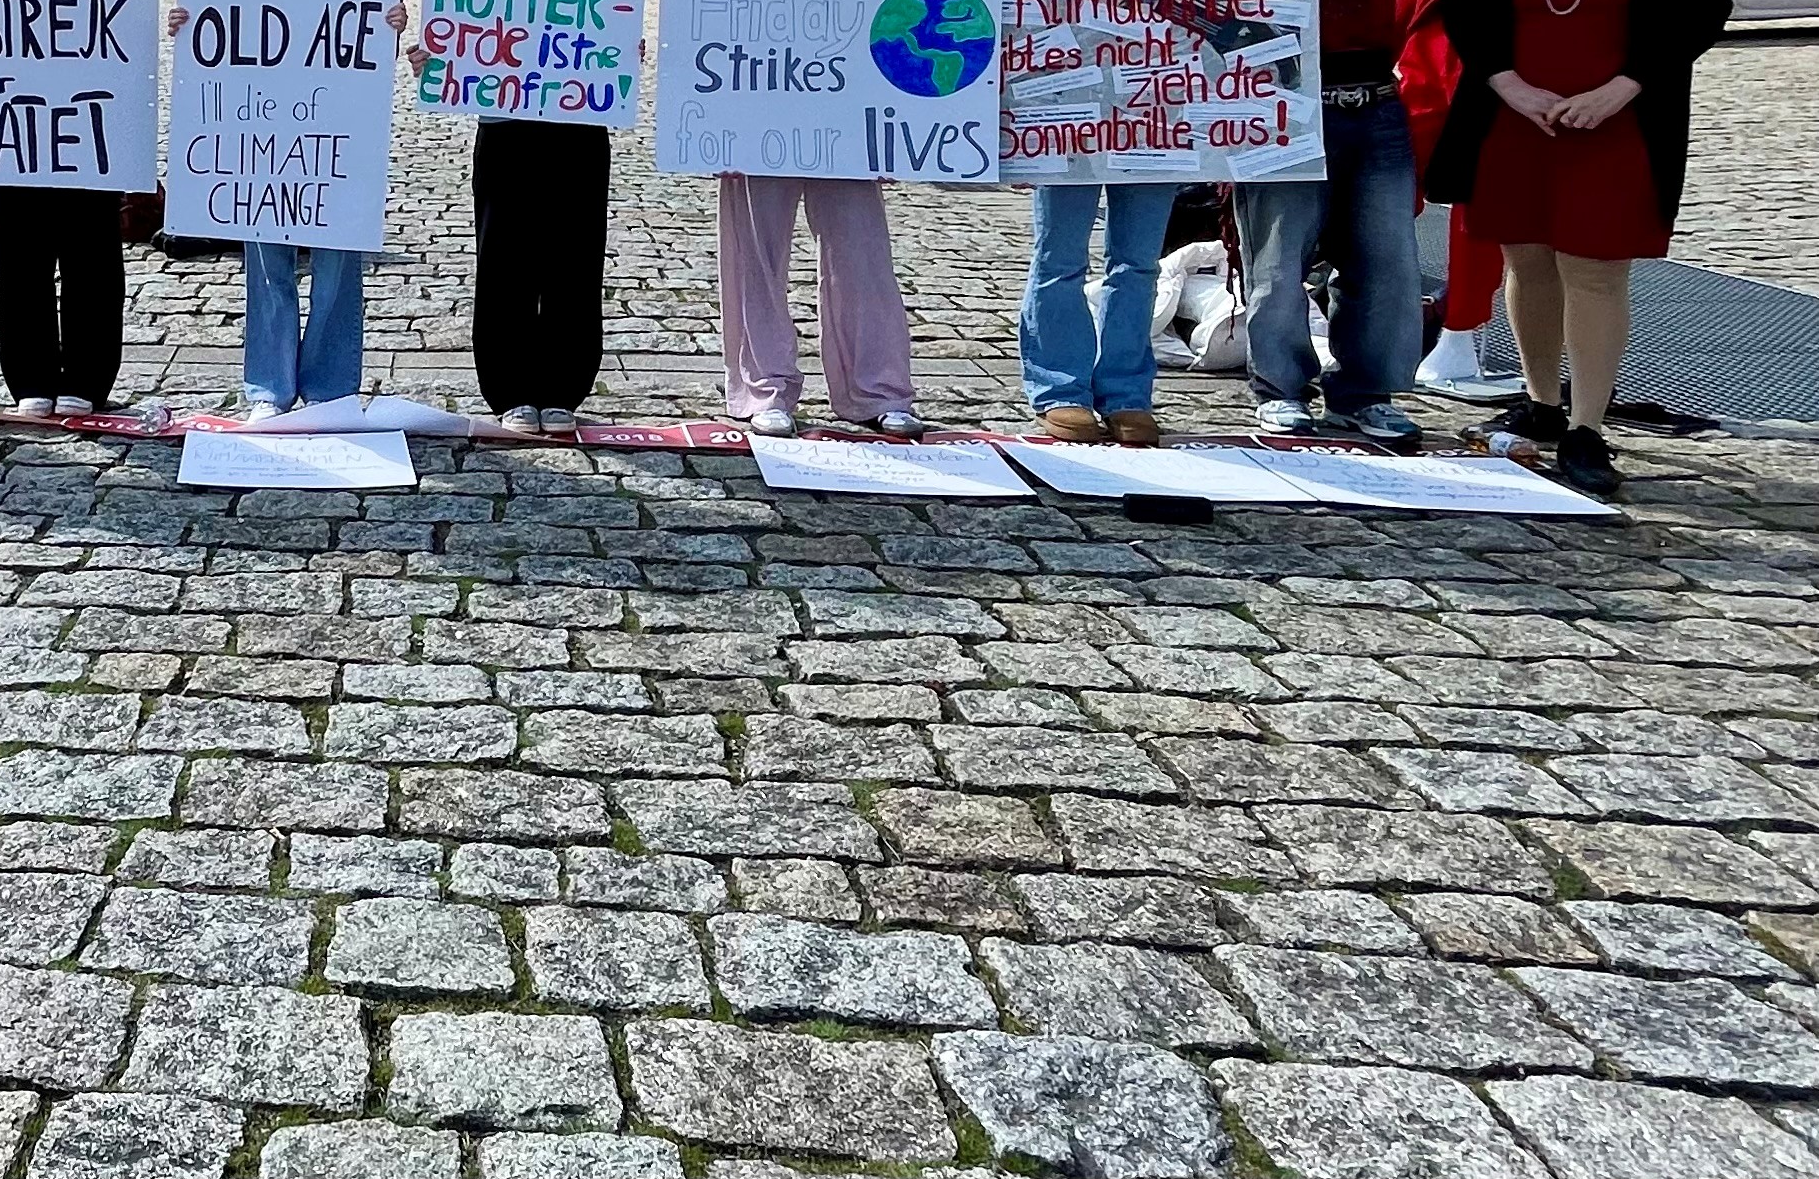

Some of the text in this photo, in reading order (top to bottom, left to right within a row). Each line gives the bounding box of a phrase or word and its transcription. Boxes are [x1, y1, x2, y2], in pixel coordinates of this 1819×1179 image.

[191, 1, 383, 71] OLD AGE
[424, 16, 529, 68] erde
[538, 24, 596, 70] ist
[1001, 33, 1042, 72] ibt
[419, 58, 633, 112] Ehrenfrau!
[694, 42, 846, 94] Strikes
[1126, 53, 1277, 110] zieh die
[236, 83, 277, 121] die
[292, 87, 329, 121] of
[186, 133, 351, 179] CLIMATE
[676, 100, 990, 179] for our lives
[999, 104, 1192, 160] Sonnenbrille
[1208, 99, 1291, 148] aus!
[208, 182, 330, 228] CHANGE
